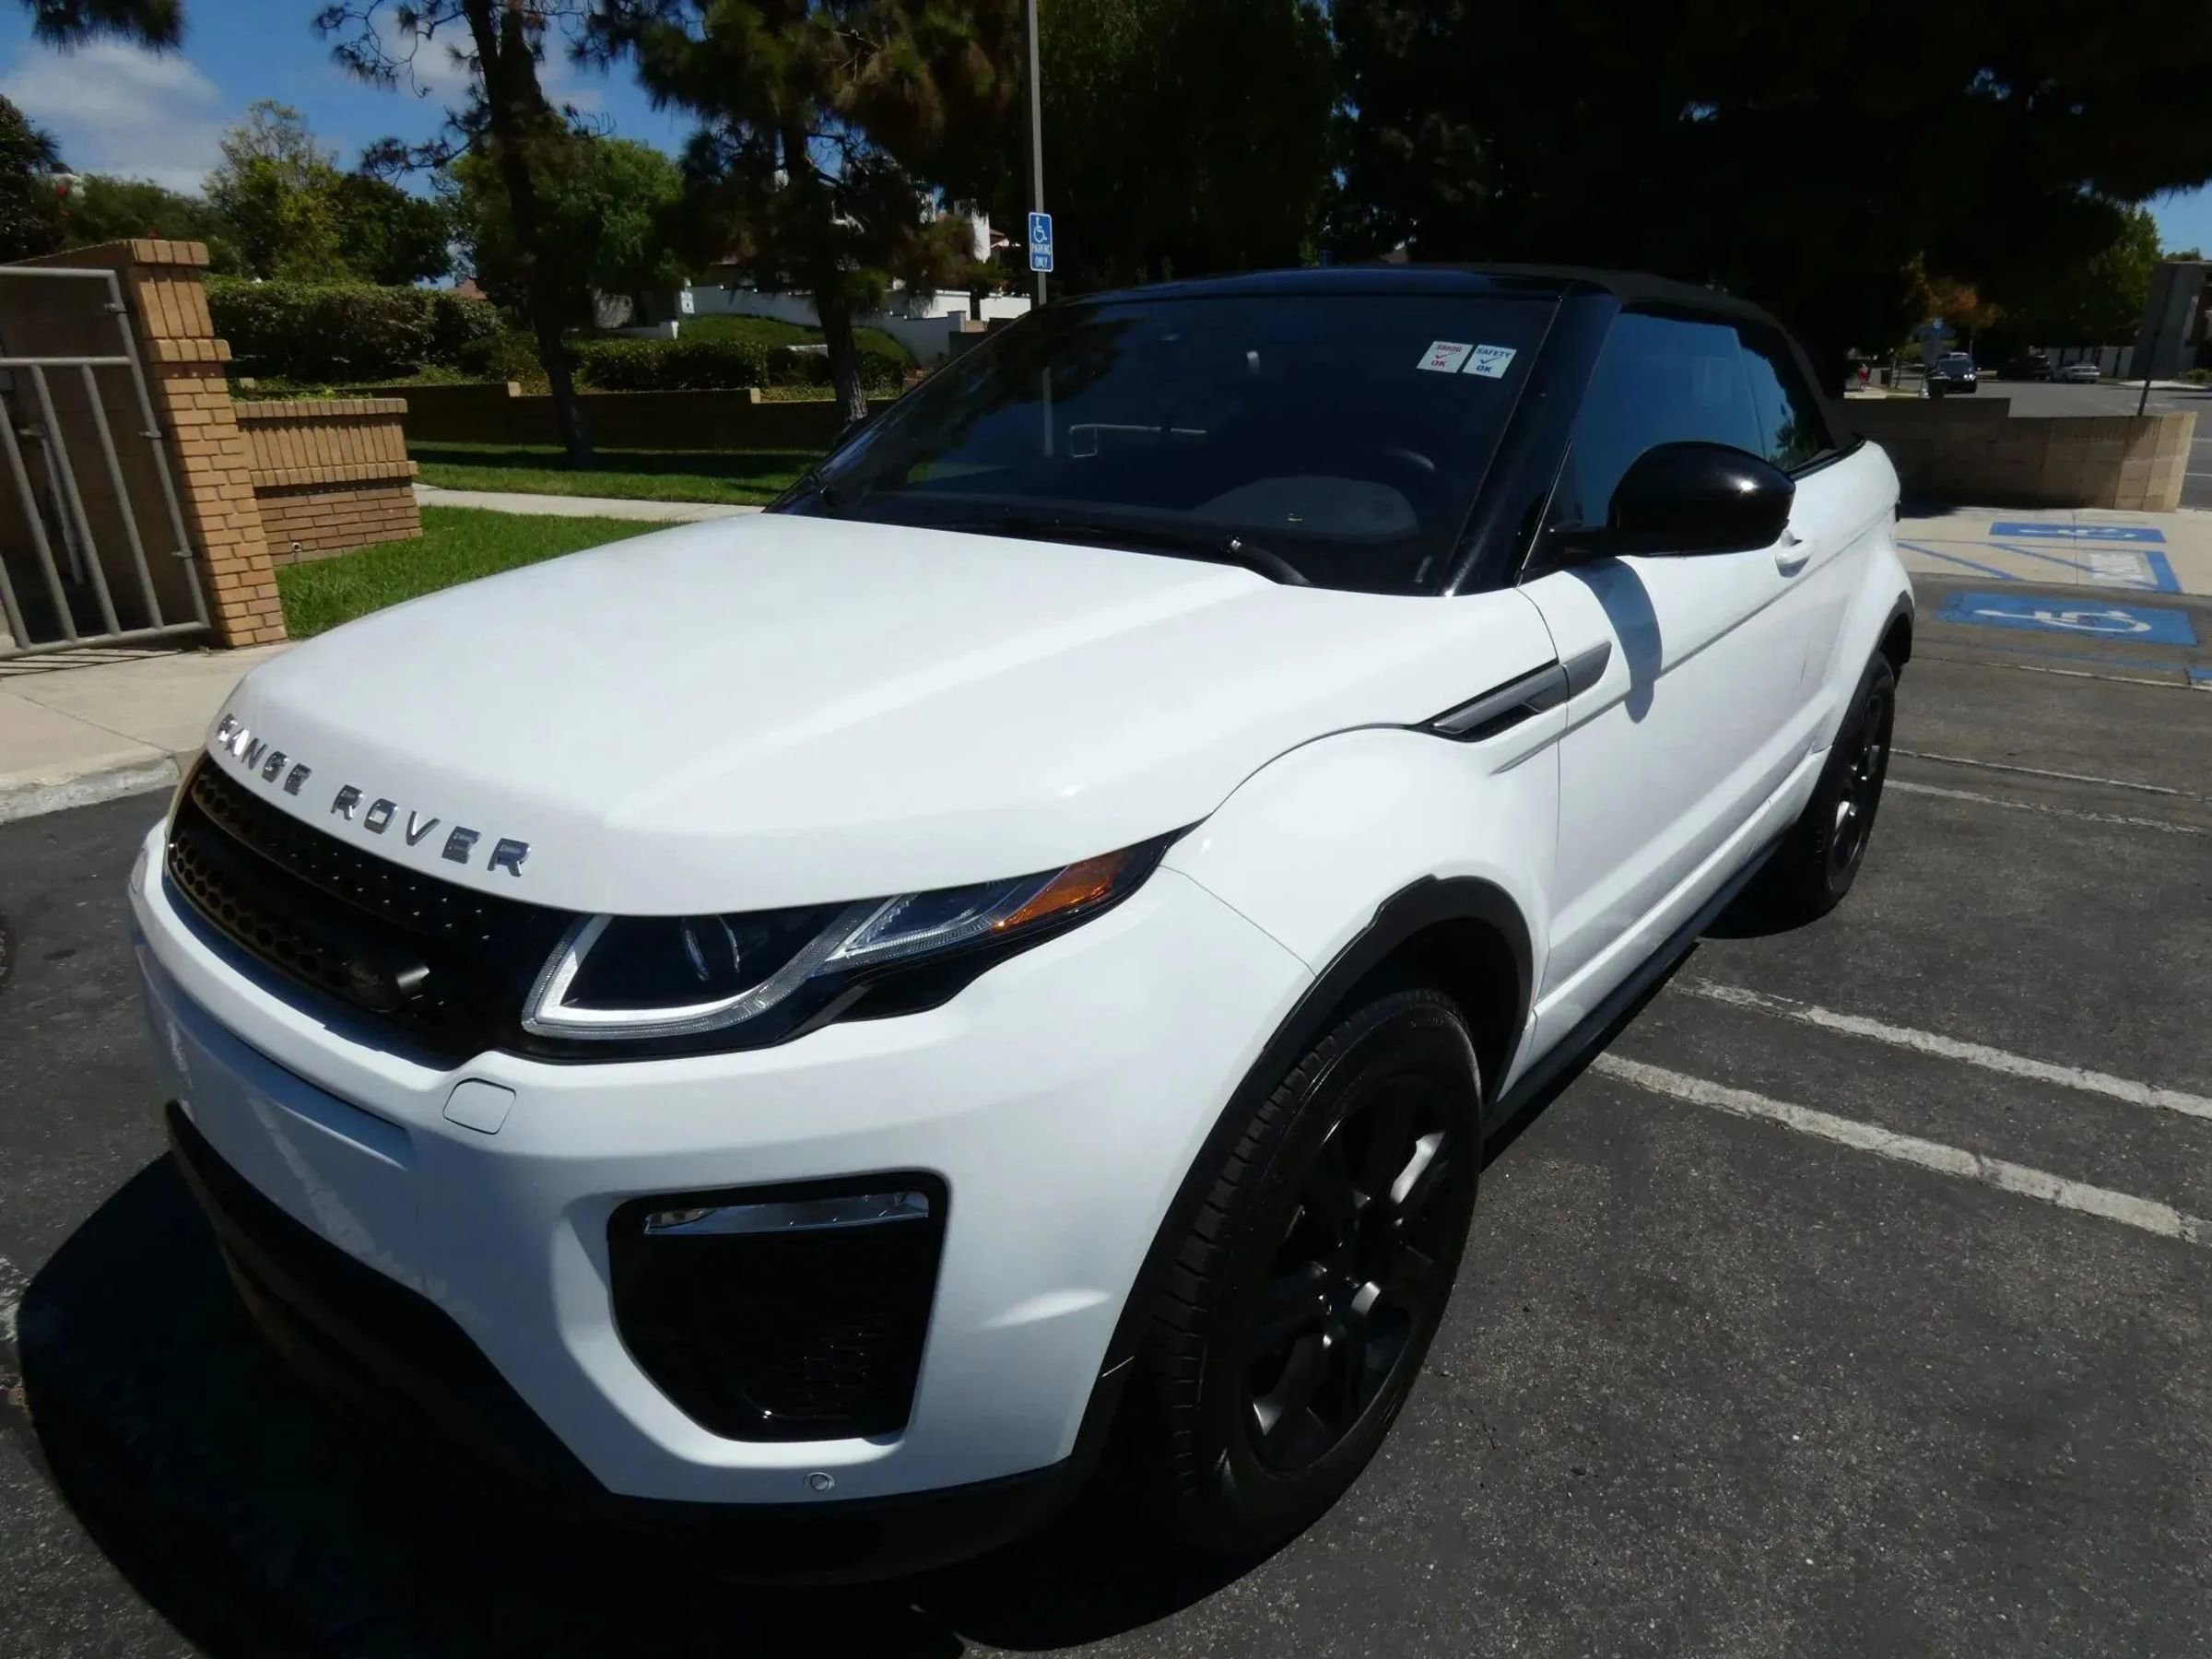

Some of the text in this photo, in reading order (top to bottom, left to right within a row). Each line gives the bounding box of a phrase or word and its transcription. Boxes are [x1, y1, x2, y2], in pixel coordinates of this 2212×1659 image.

[1476, 347, 1512, 359] SAFETY
[1430, 359, 1446, 368] OK
[1476, 364, 1493, 373] OK
[217, 713, 532, 877] RANGE ROVER
